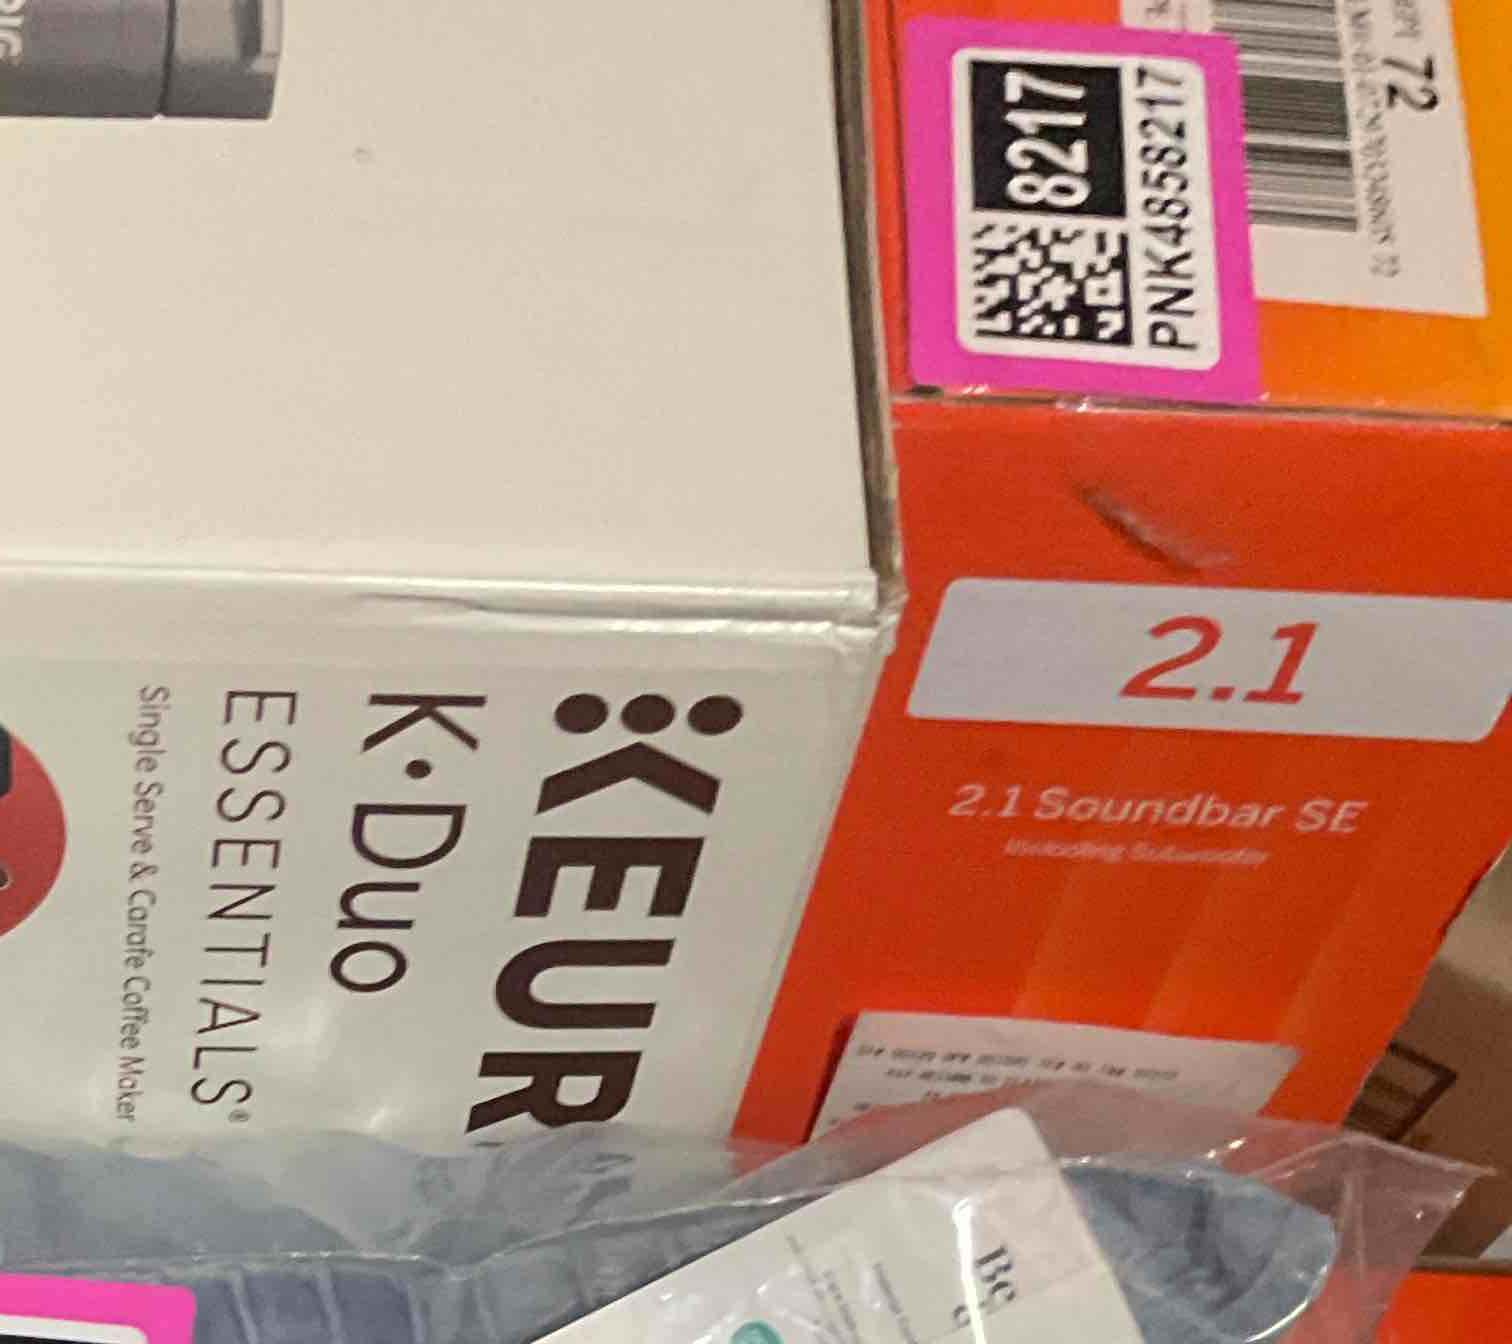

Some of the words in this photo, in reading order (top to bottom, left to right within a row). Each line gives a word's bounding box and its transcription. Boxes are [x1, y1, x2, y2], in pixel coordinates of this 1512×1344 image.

[1382, 54, 1440, 113] 72
[1005, 70, 1090, 209] 8217
[1136, 65, 1199, 351] PNK4858217
[1118, 614, 1319, 704] 2.1
[128, 684, 171, 774] Single
[131, 780, 164, 859] Serve
[948, 784, 1022, 820] 2.1
[1033, 786, 1286, 830] Soundbar
[1295, 798, 1368, 834] SE
[128, 862, 160, 882] &
[124, 887, 157, 970] Carafe
[464, 692, 744, 1136] KEUR
[120, 974, 152, 1051] Coffee
[115, 1054, 146, 1123] Maker
